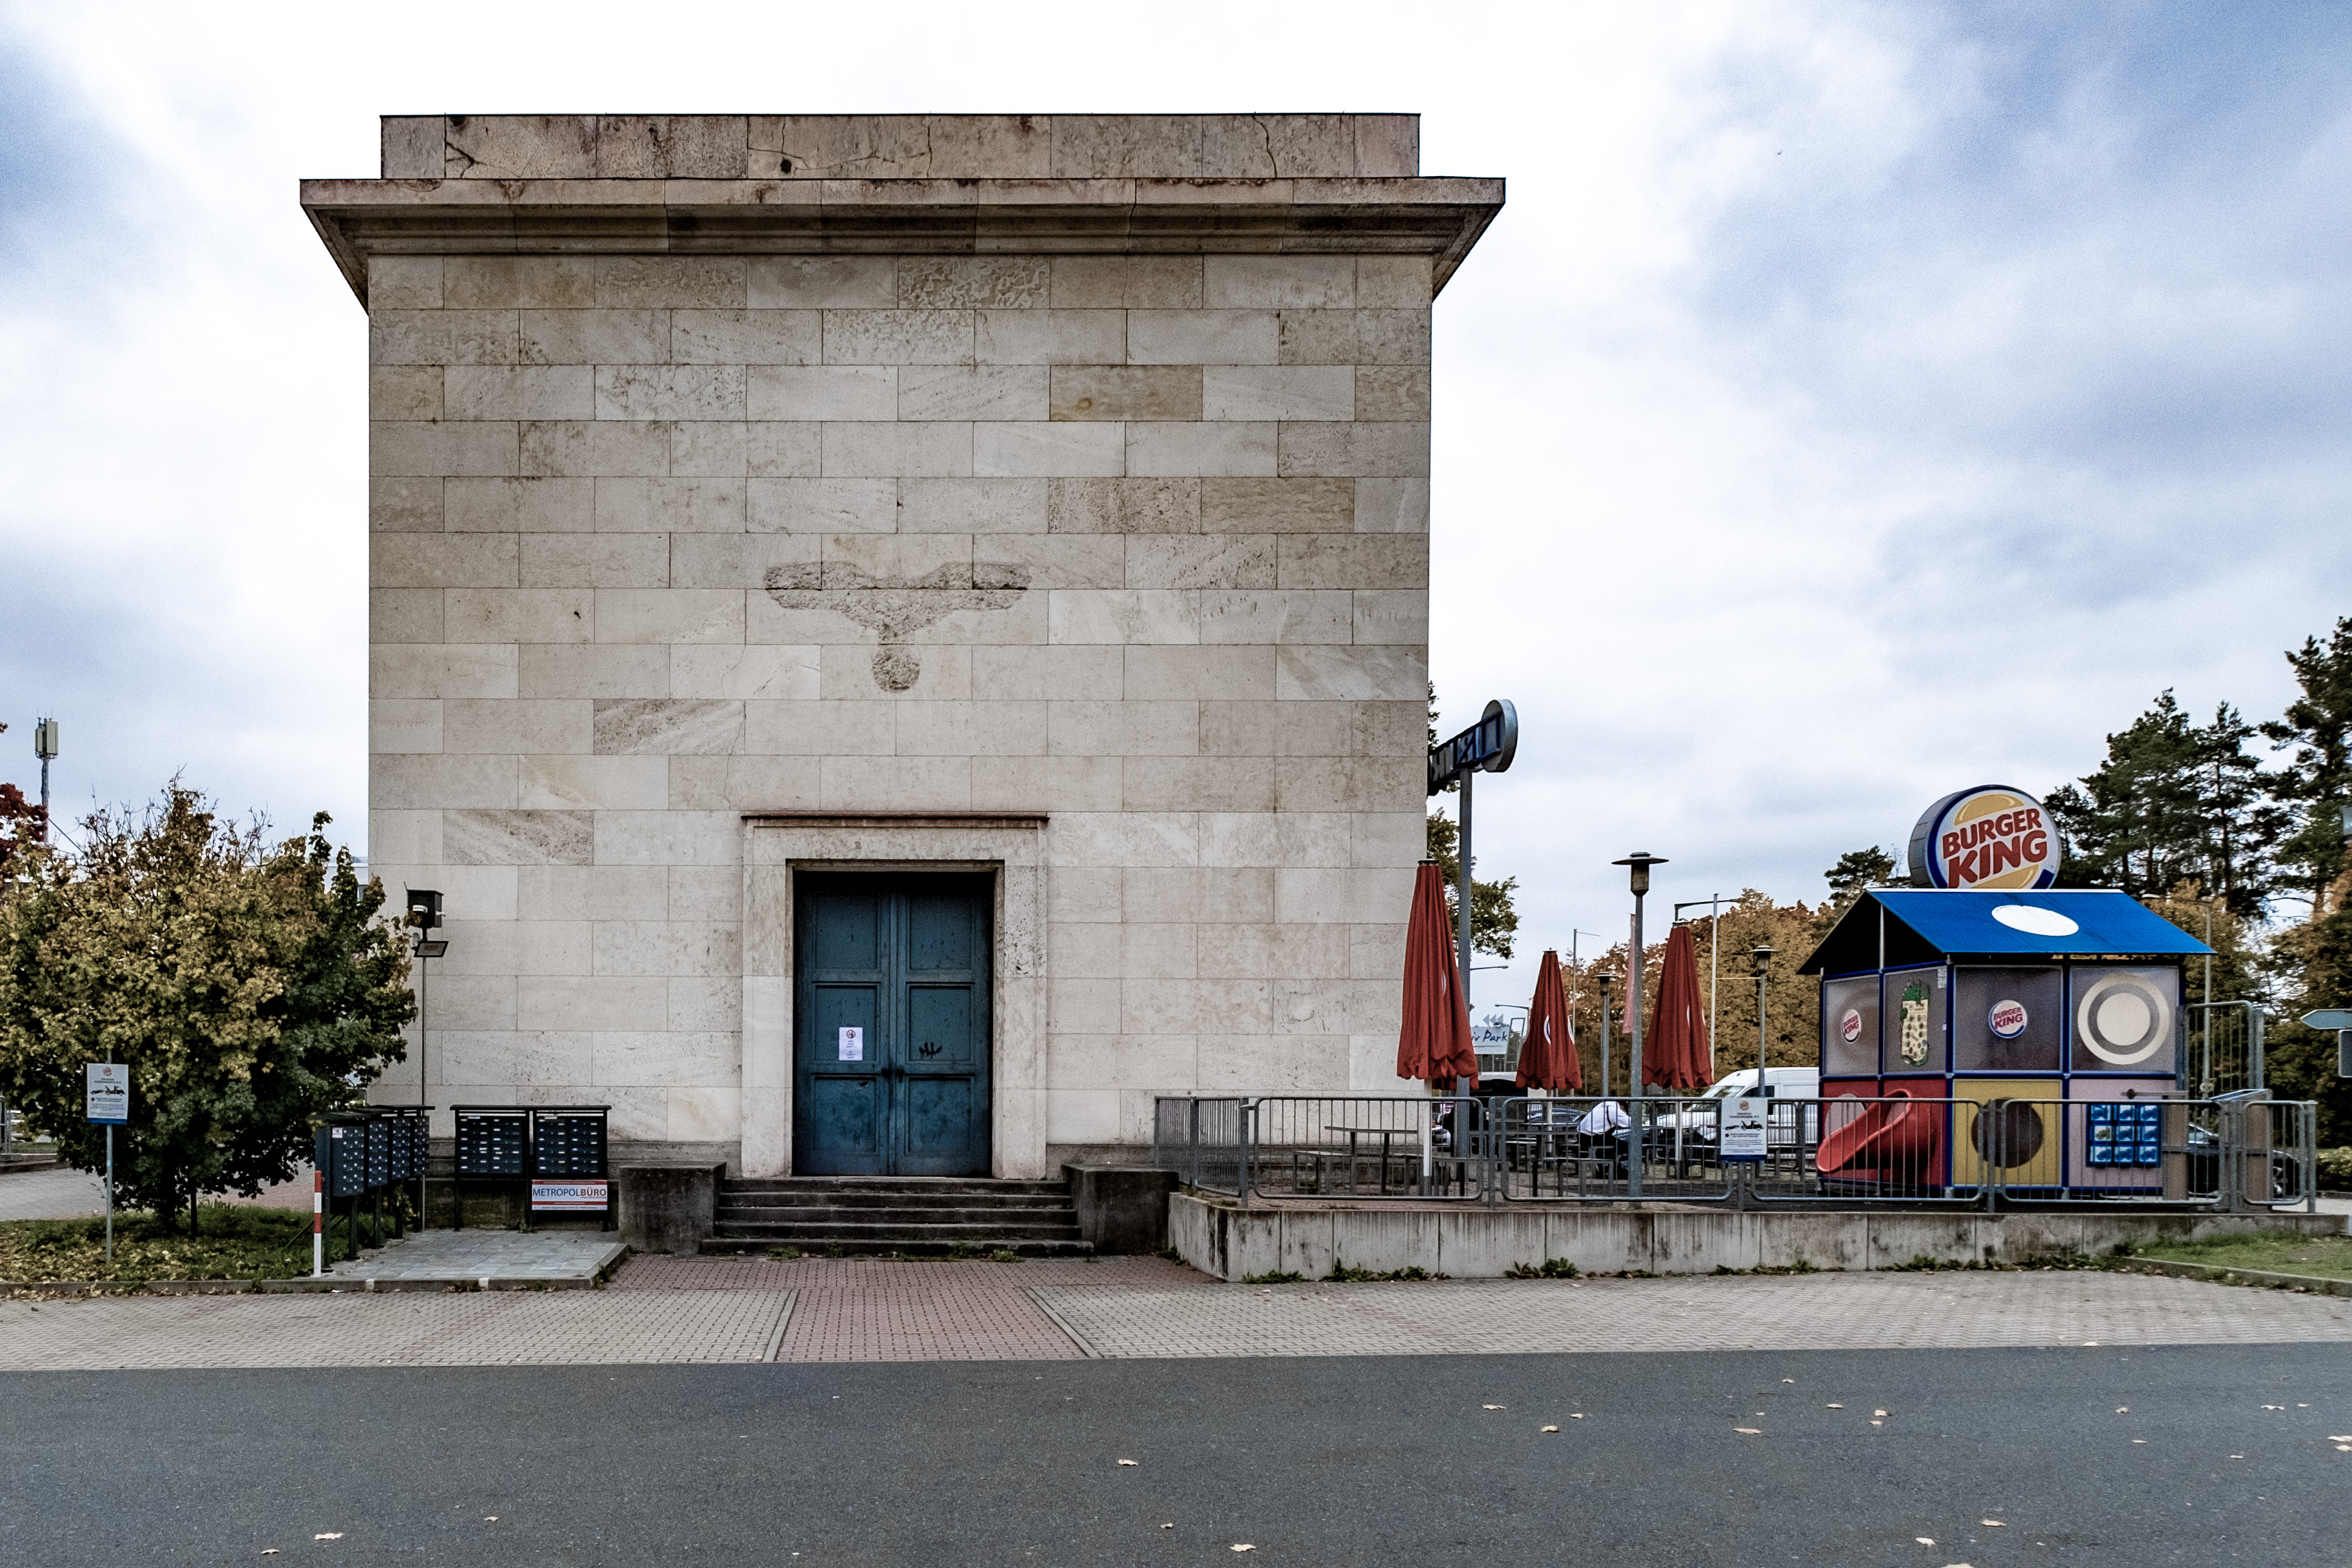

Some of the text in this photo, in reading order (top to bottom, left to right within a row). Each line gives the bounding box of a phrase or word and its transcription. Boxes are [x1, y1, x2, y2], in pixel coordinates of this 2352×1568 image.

[1942, 808, 2042, 859] BURGER
[1948, 830, 2047, 889] KING
[1993, 1007, 2022, 1021] BURGER
[1995, 1013, 2024, 1029] KING
[1482, 1029, 1508, 1042] Park
[532, 1187, 607, 1197] METROPOLBÜRO
